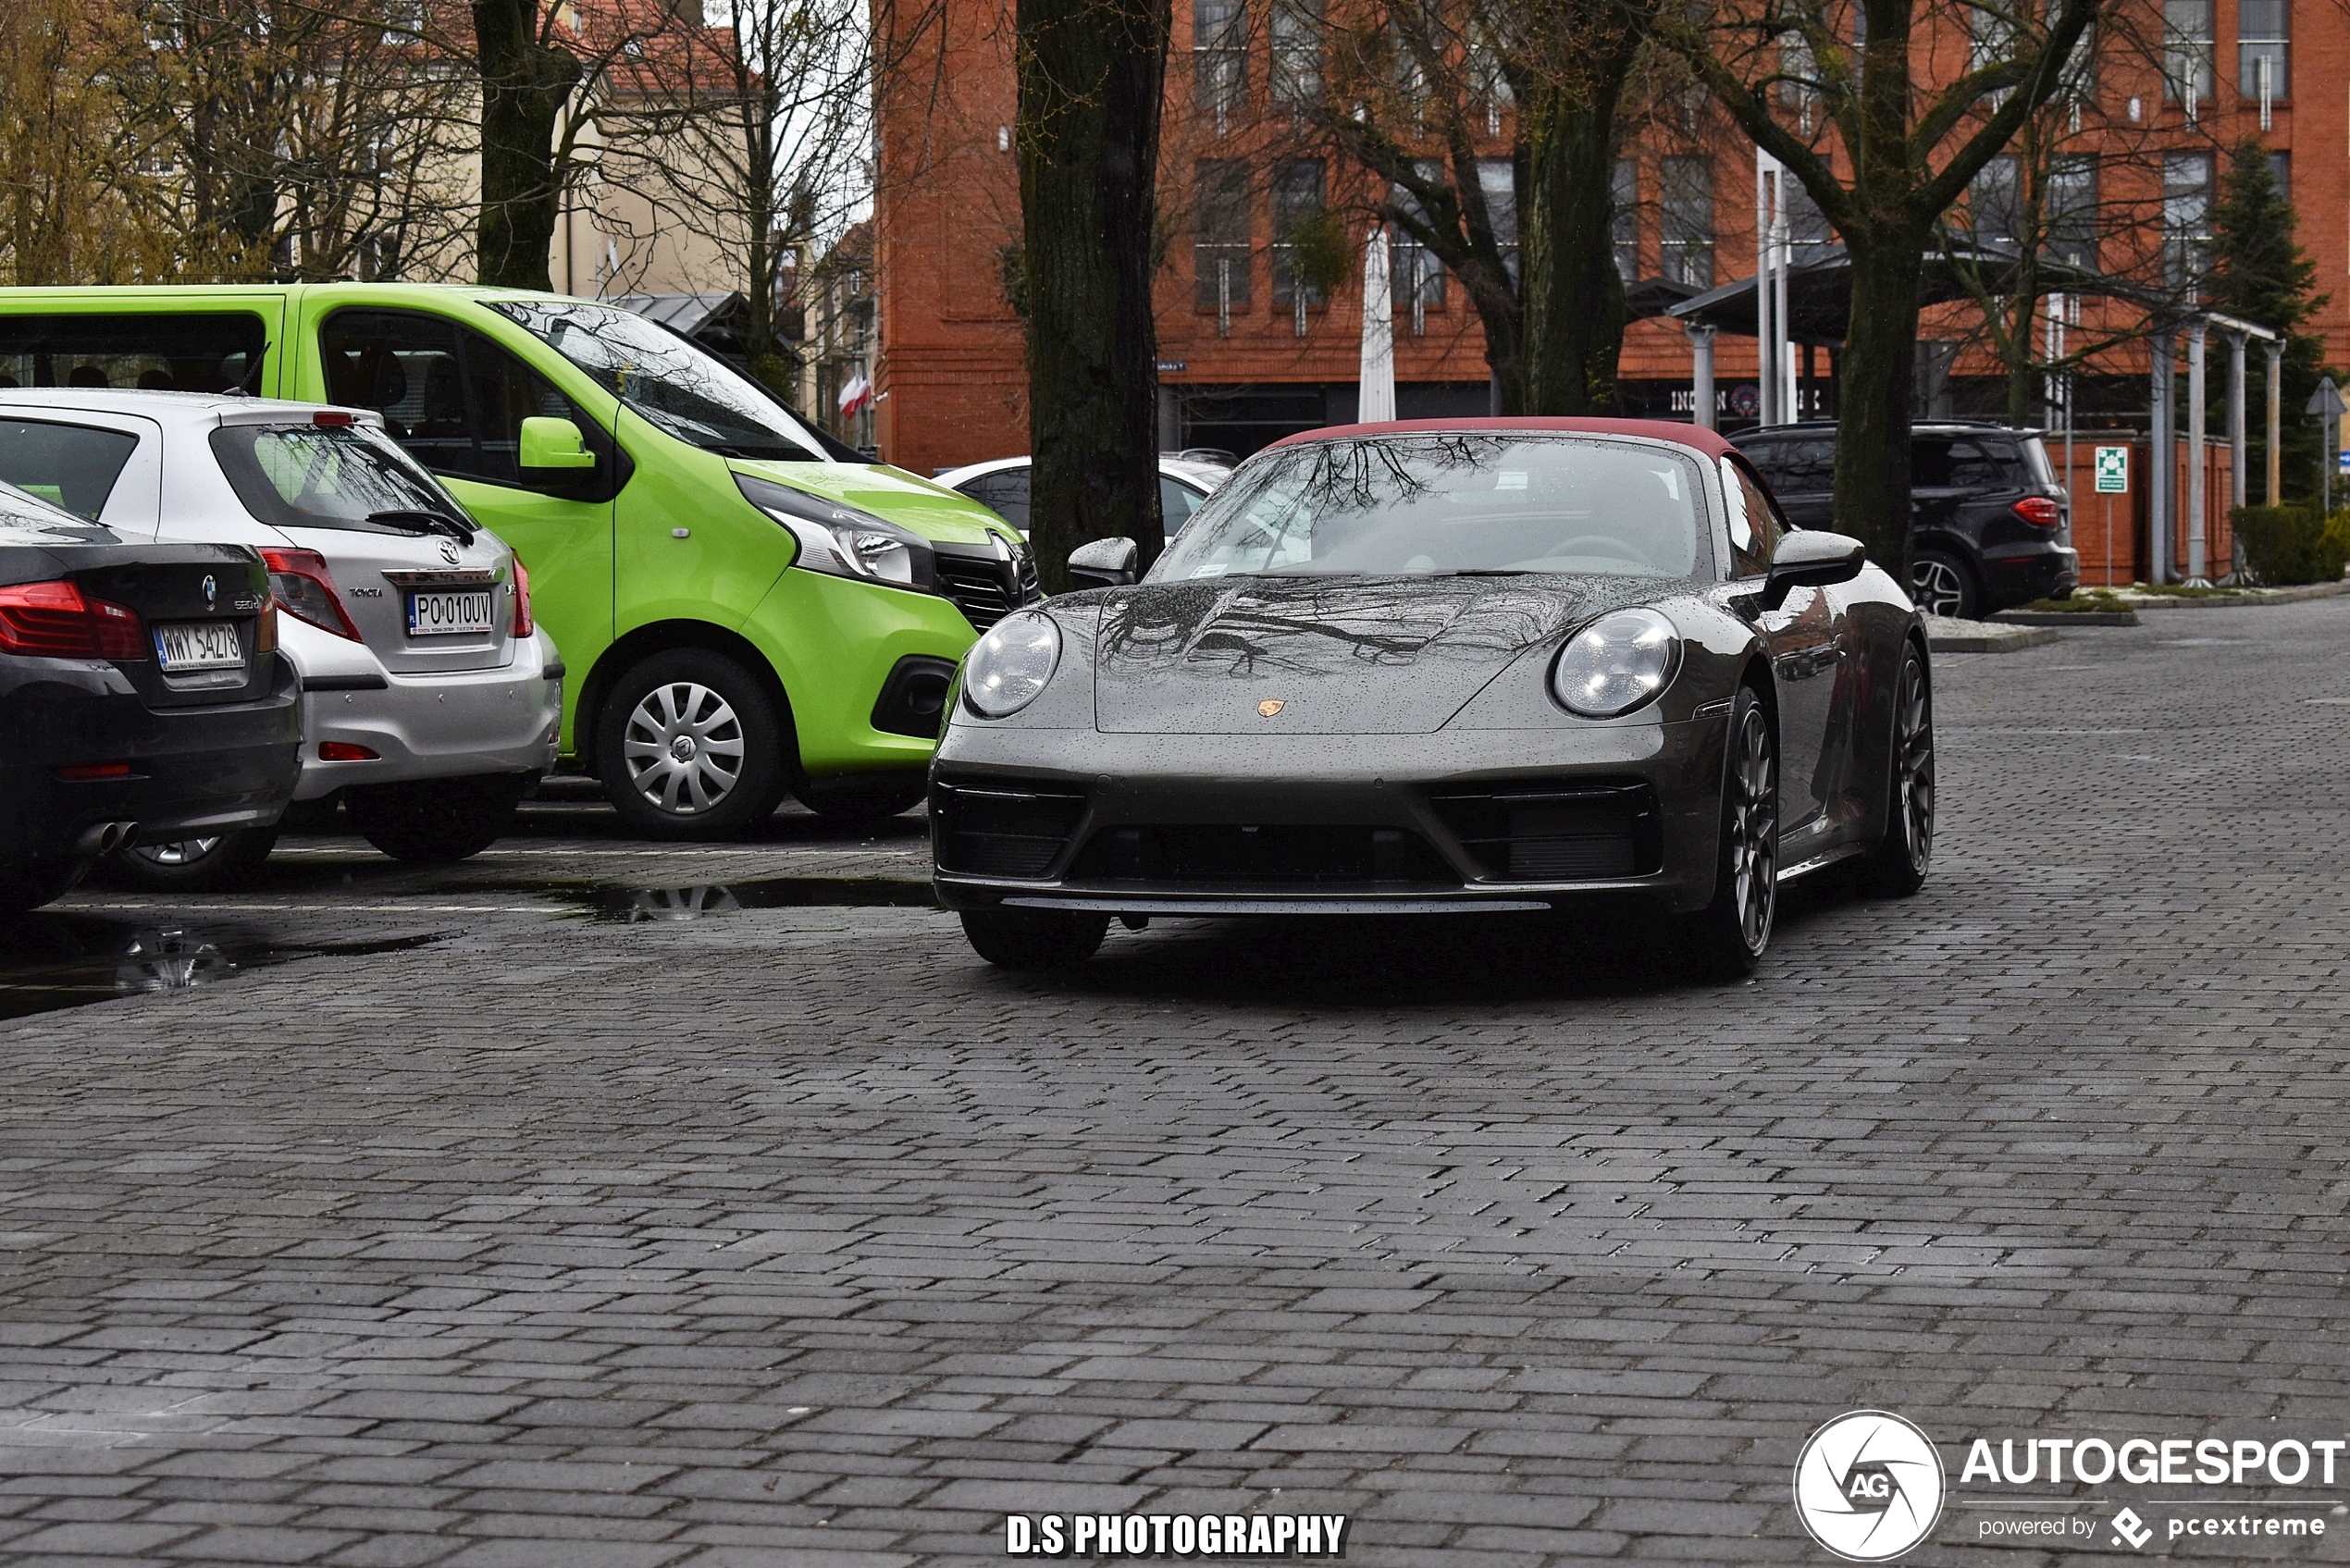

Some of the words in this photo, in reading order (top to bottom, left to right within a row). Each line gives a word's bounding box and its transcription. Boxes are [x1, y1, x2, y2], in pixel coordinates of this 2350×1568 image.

[1671, 390, 1726, 411] INDN
[350, 587, 383, 598] TOYOTA
[234, 598, 259, 610] 520d
[418, 597, 440, 625] PO
[446, 596, 489, 624] 010UV
[162, 627, 192, 661] WWY
[195, 626, 239, 659] 54278
